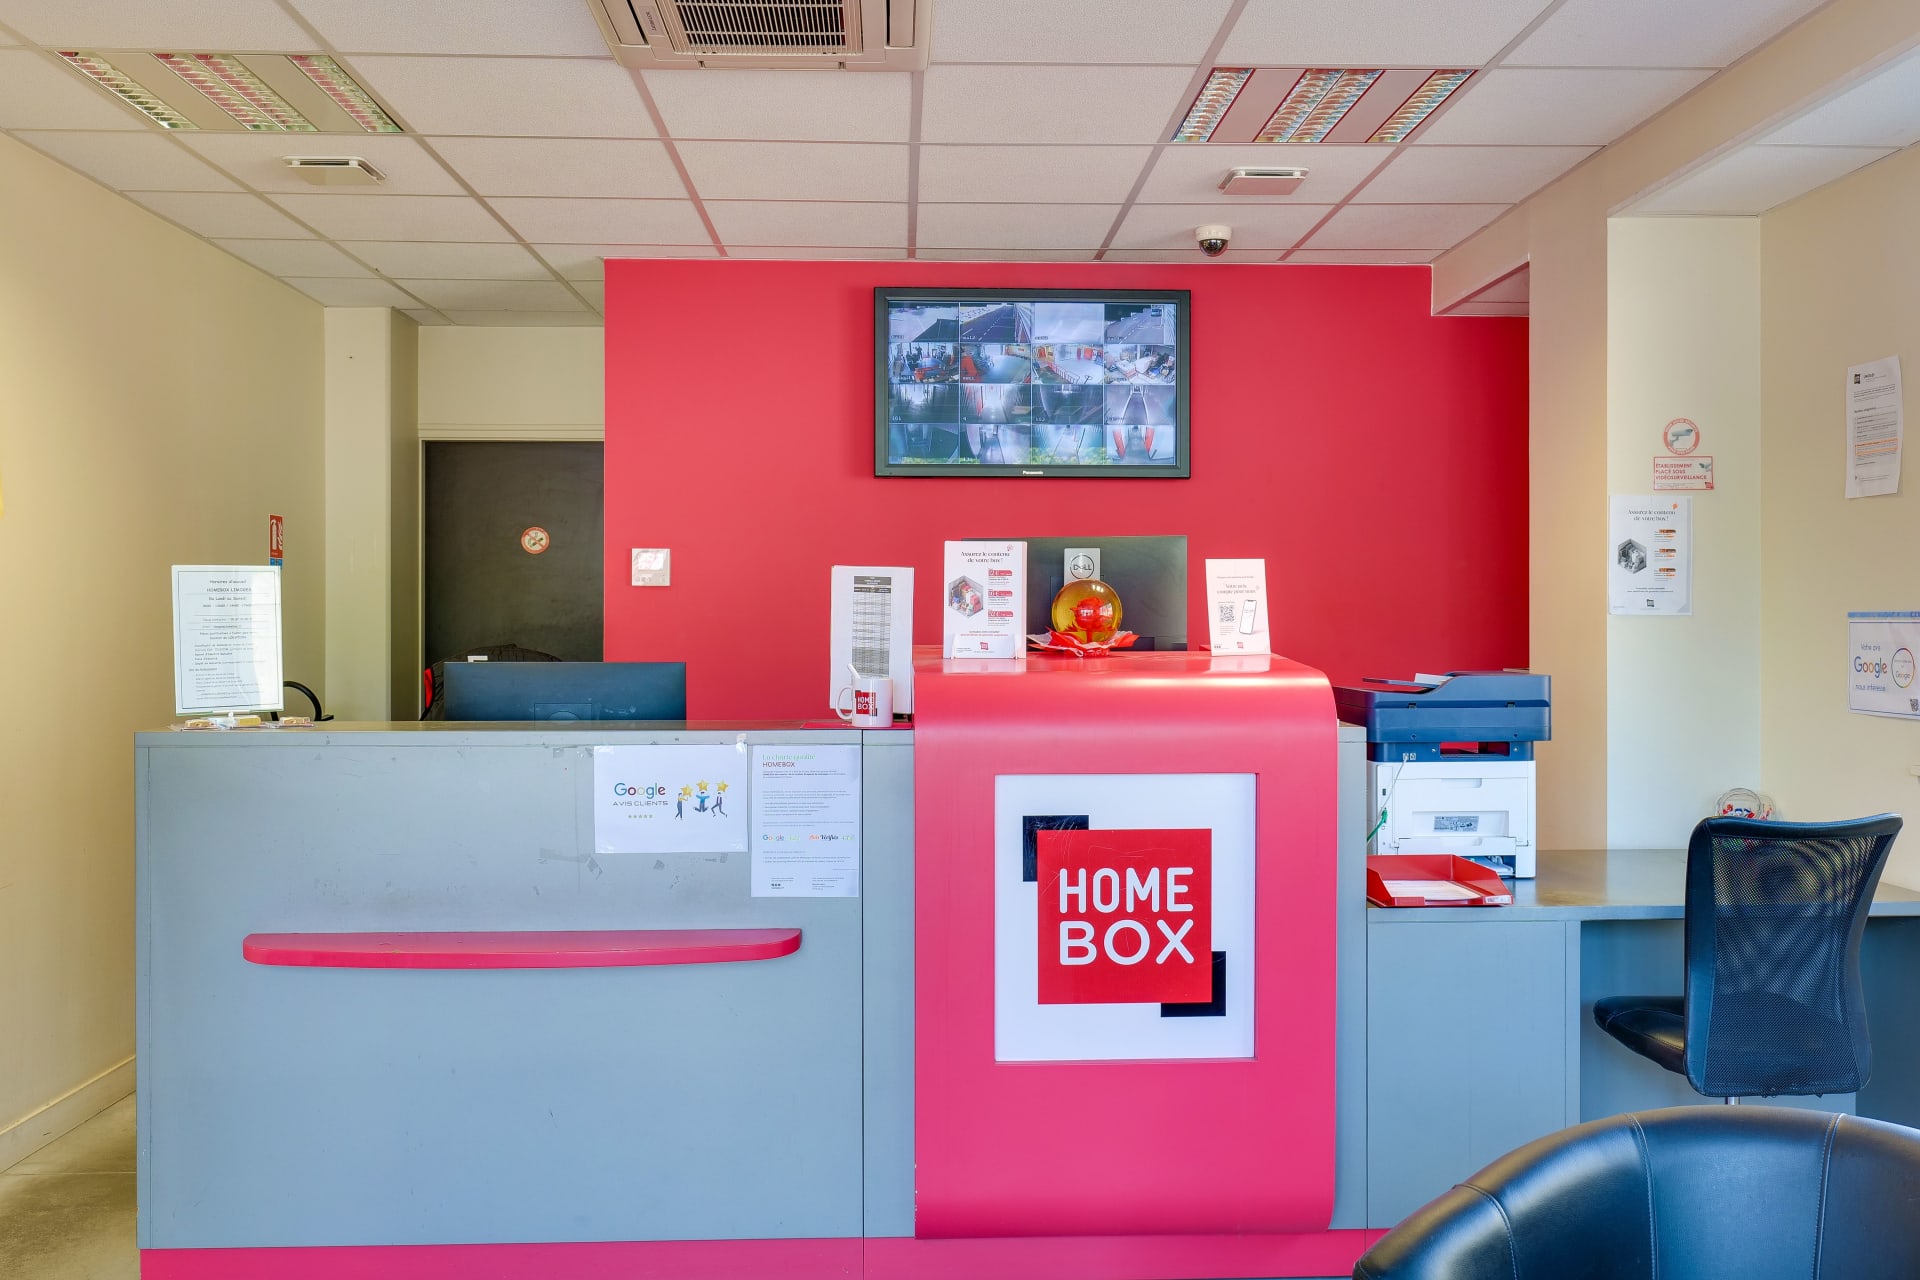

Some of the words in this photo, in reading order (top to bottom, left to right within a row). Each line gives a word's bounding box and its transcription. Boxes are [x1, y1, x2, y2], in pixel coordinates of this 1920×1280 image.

[1854, 655, 1888, 679] Google
[614, 782, 666, 799] Google
[1059, 867, 1194, 913] HOME
[1059, 918, 1195, 965] BOX
